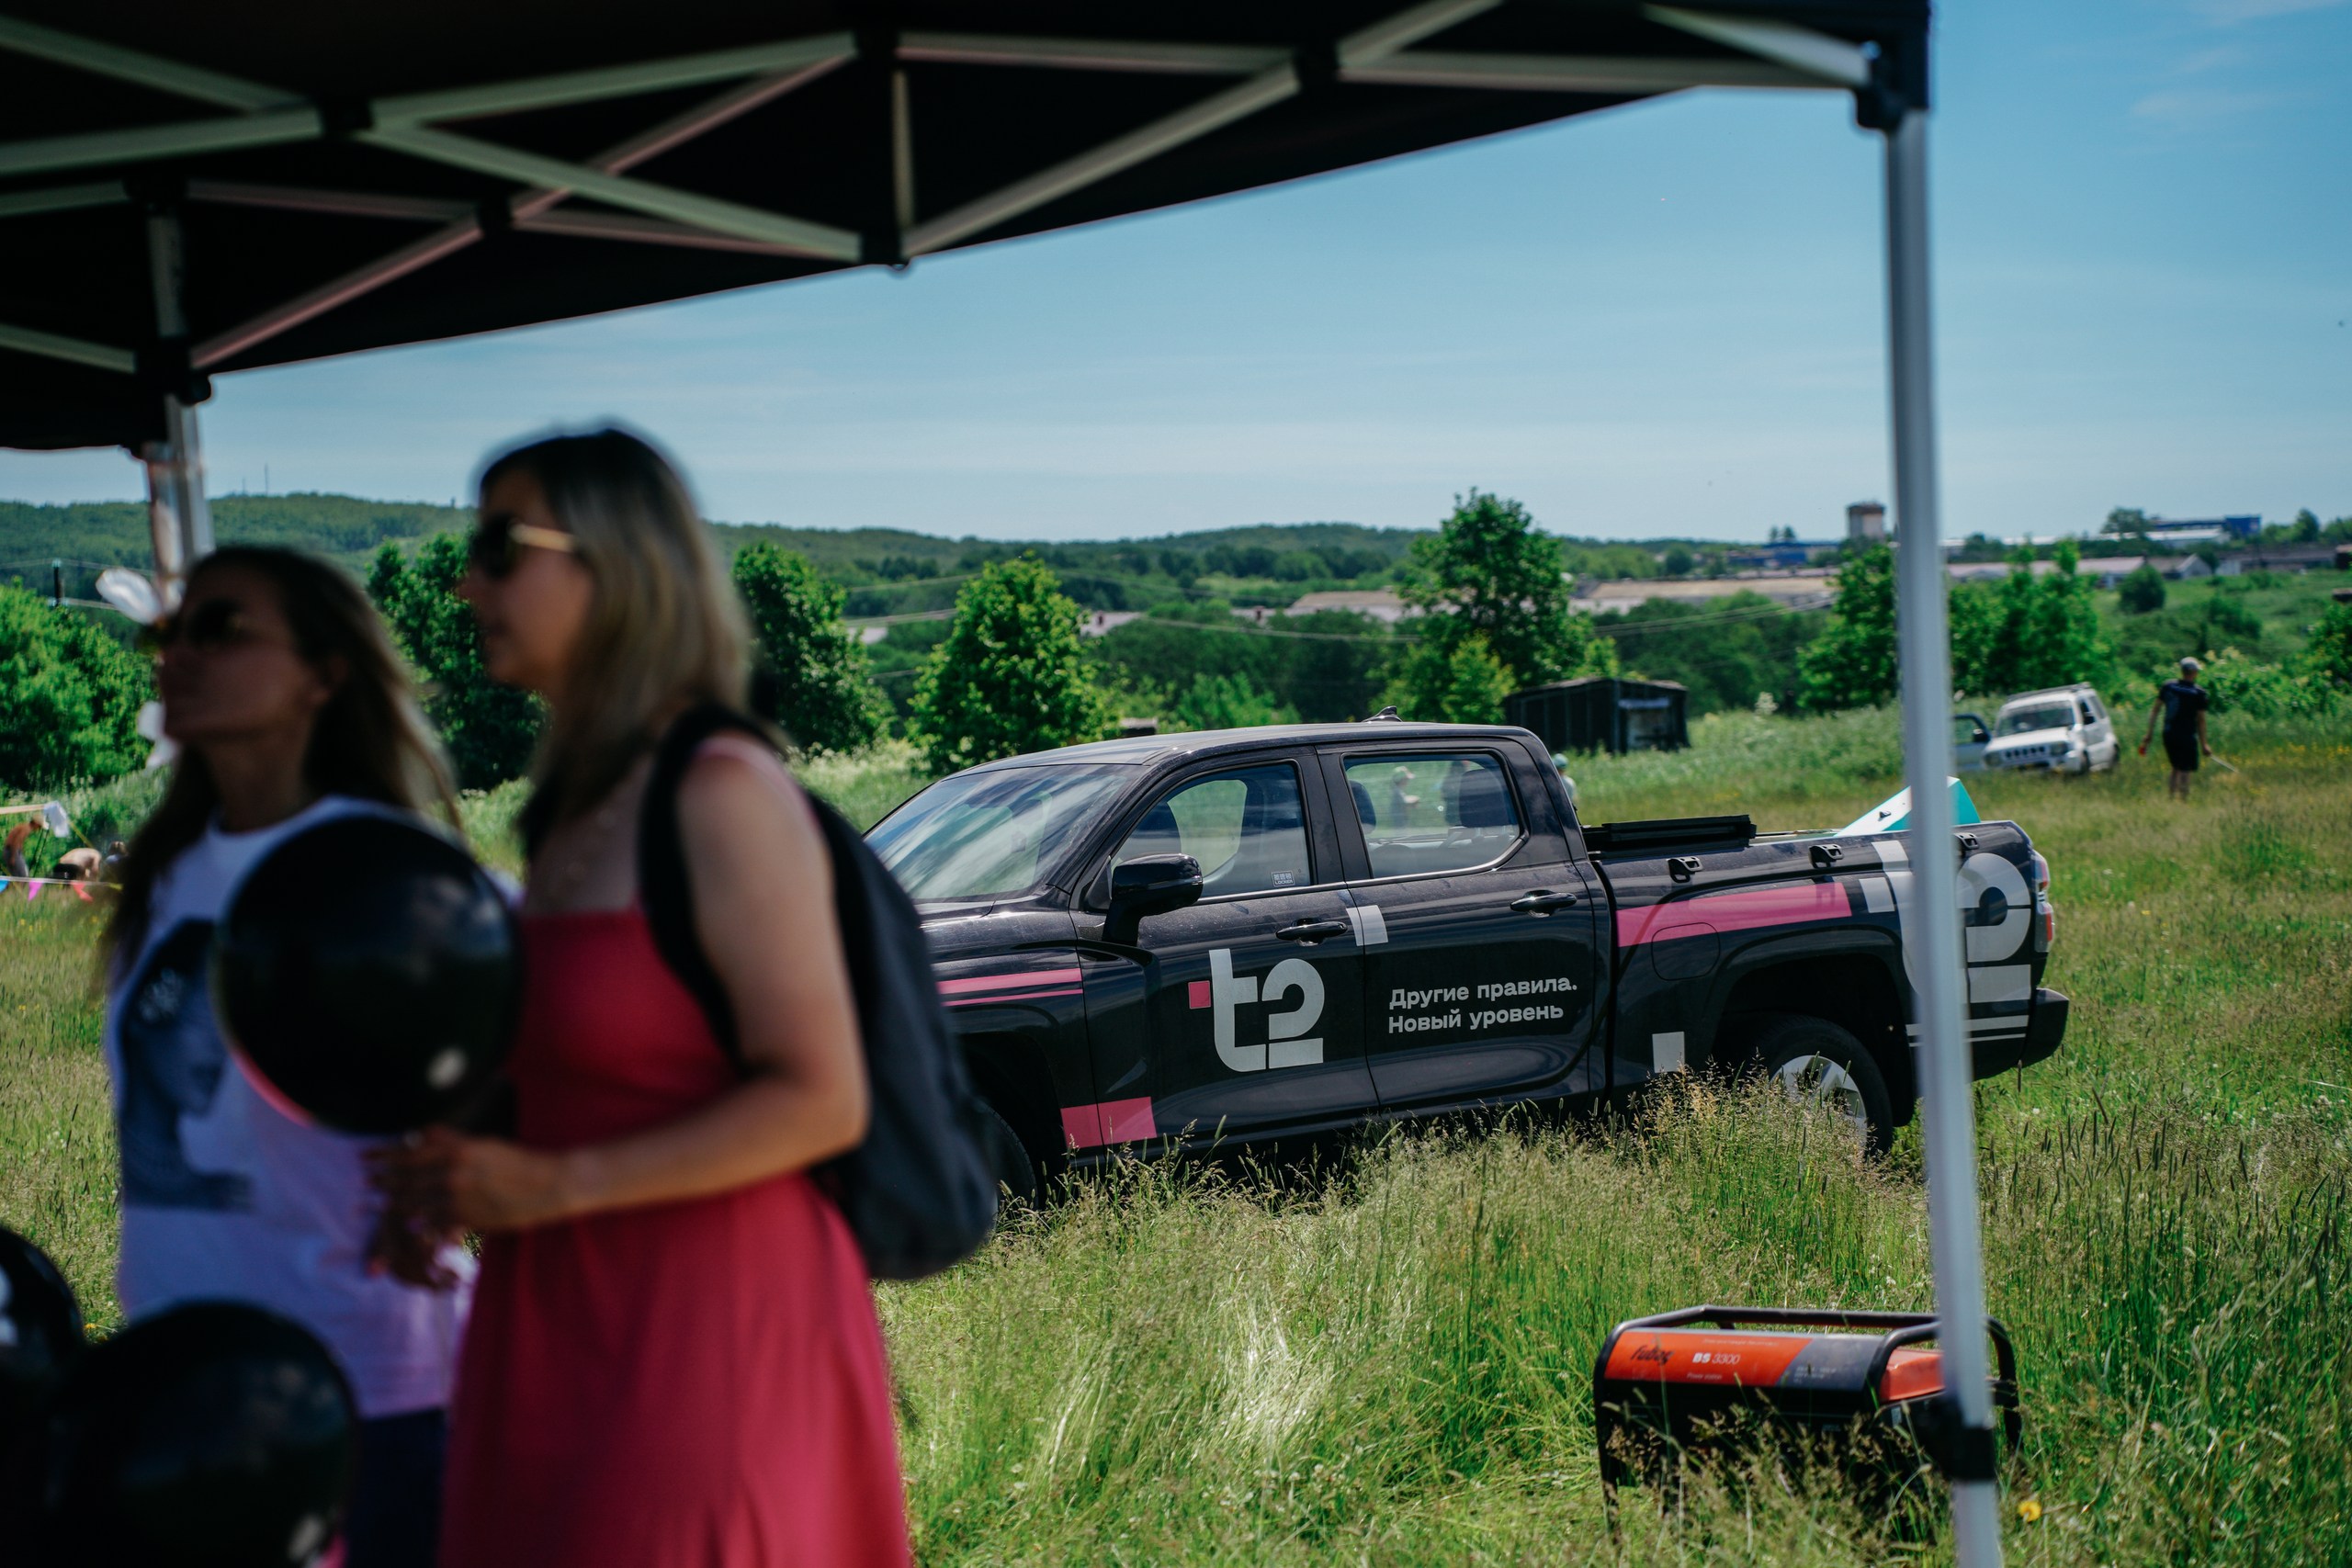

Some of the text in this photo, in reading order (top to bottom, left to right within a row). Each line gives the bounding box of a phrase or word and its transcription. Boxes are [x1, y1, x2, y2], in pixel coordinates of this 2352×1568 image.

[1389, 977, 1577, 1010] Другие правила.
[1209, 948, 1325, 1072] t2
[1388, 1005, 1564, 1033] Новый уровень
[1692, 1352, 1740, 1365] BS 3300
